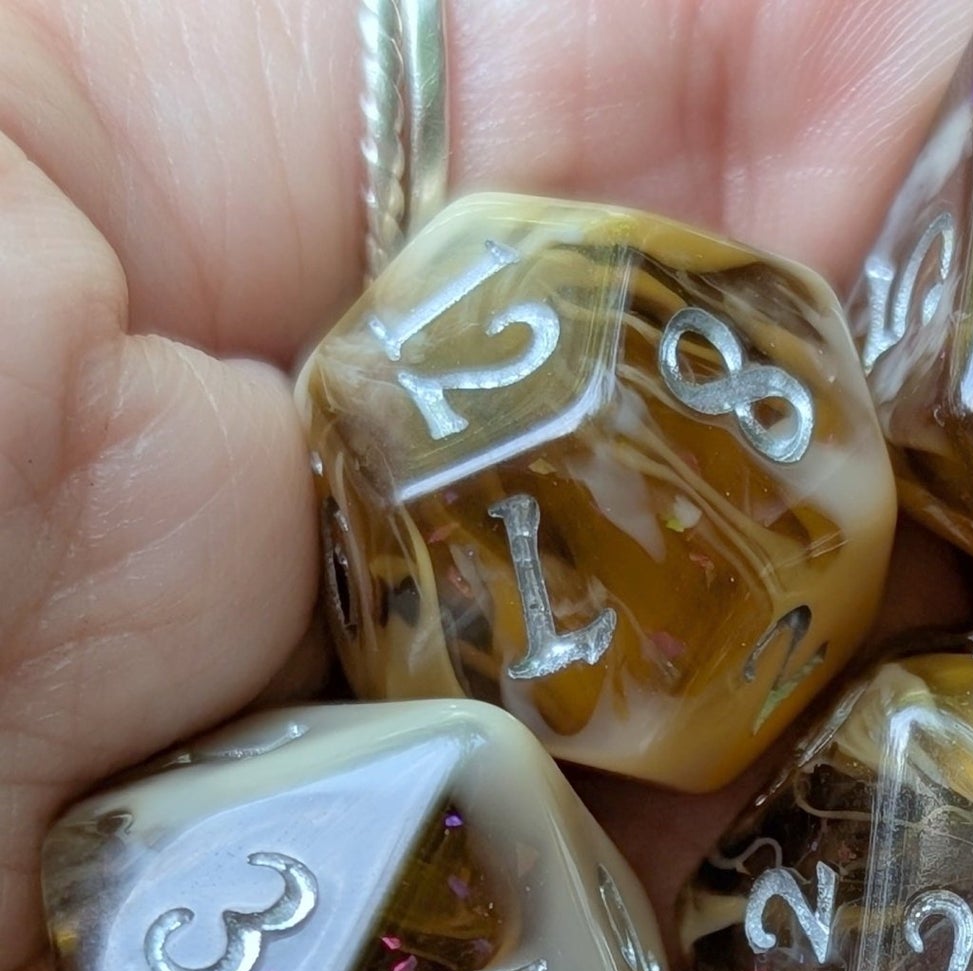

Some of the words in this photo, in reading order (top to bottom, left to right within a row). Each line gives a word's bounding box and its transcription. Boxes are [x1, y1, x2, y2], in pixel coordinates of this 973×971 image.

[372, 239, 561, 440] 12
[659, 306, 816, 463] 8
[744, 861, 839, 964] 2
